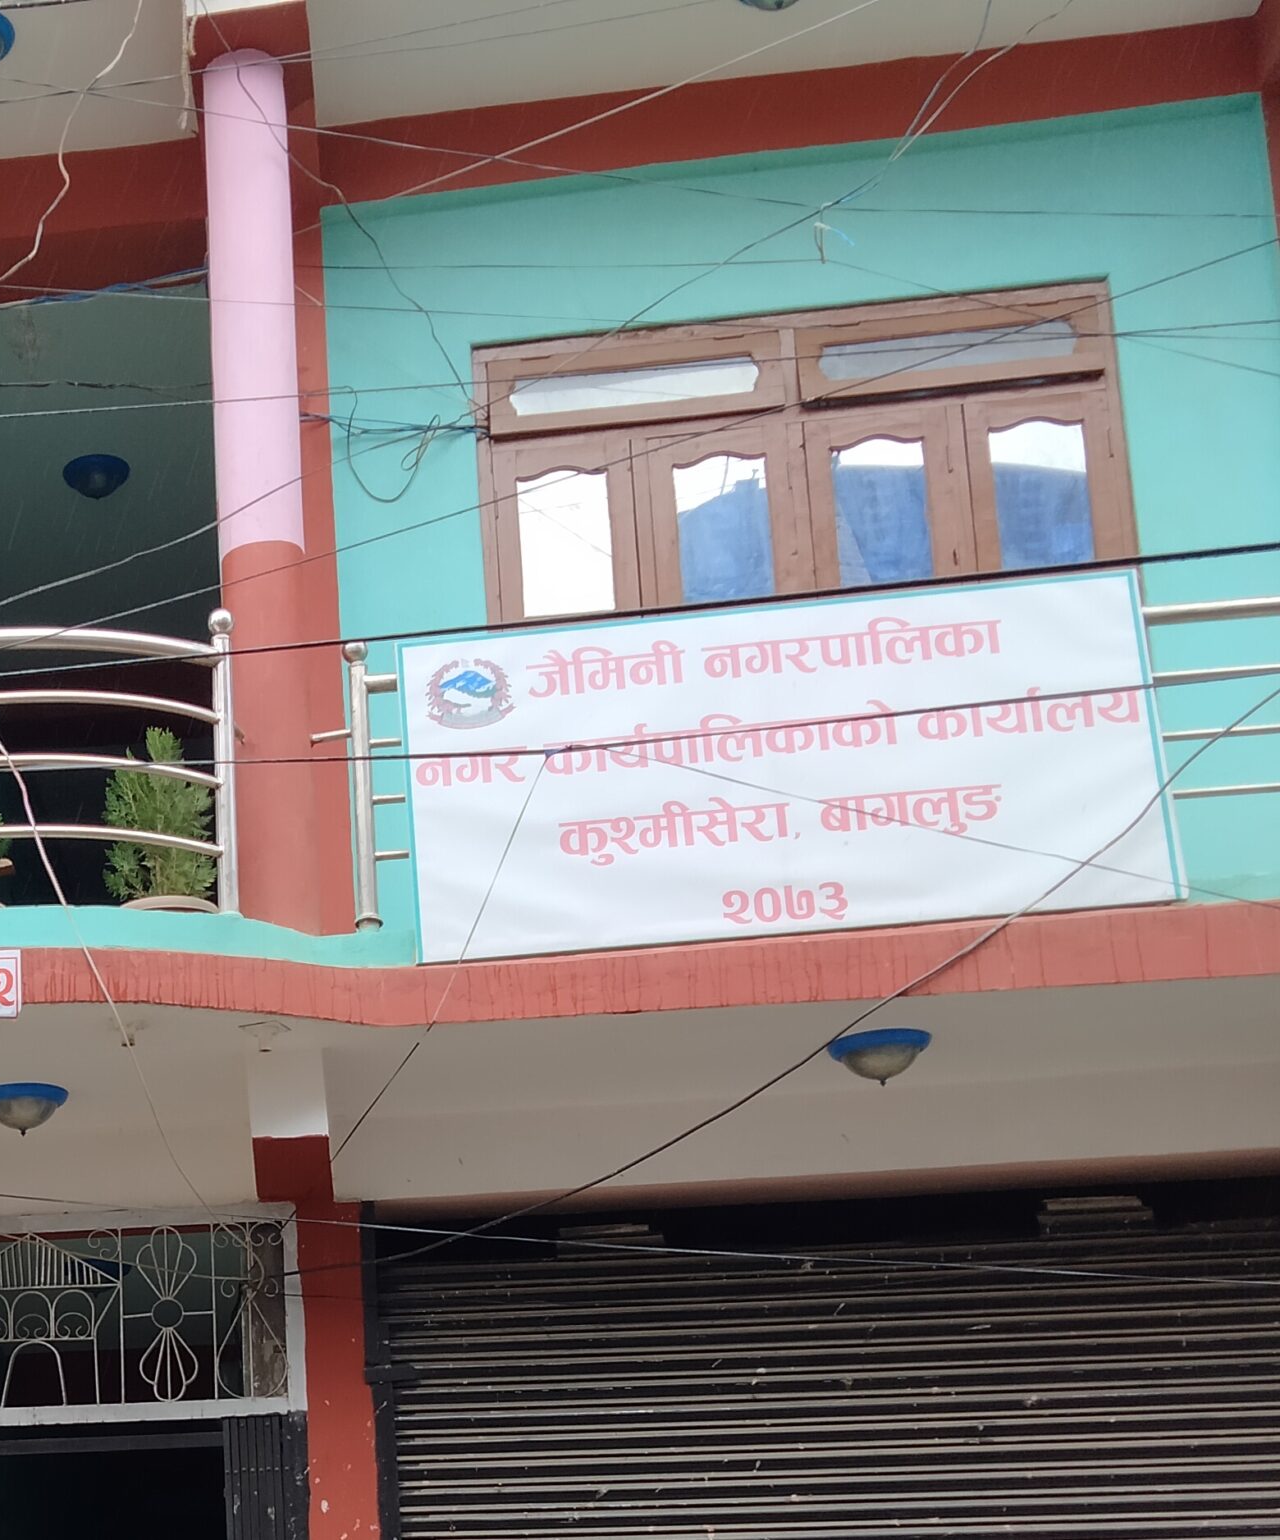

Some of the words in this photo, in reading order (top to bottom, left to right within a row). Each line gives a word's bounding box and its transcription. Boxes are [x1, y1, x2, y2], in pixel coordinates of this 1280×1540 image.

[525, 640, 685, 698] जैमिनी
[701, 616, 1002, 679] नगरपालिका
[415, 745, 527, 787] नगर
[543, 699, 899, 776] कार्यपालिकाको
[916, 686, 1142, 742] कार्यालय
[558, 796, 801, 867] कुश्मीसेरा,
[721, 880, 849, 925] २०७३
